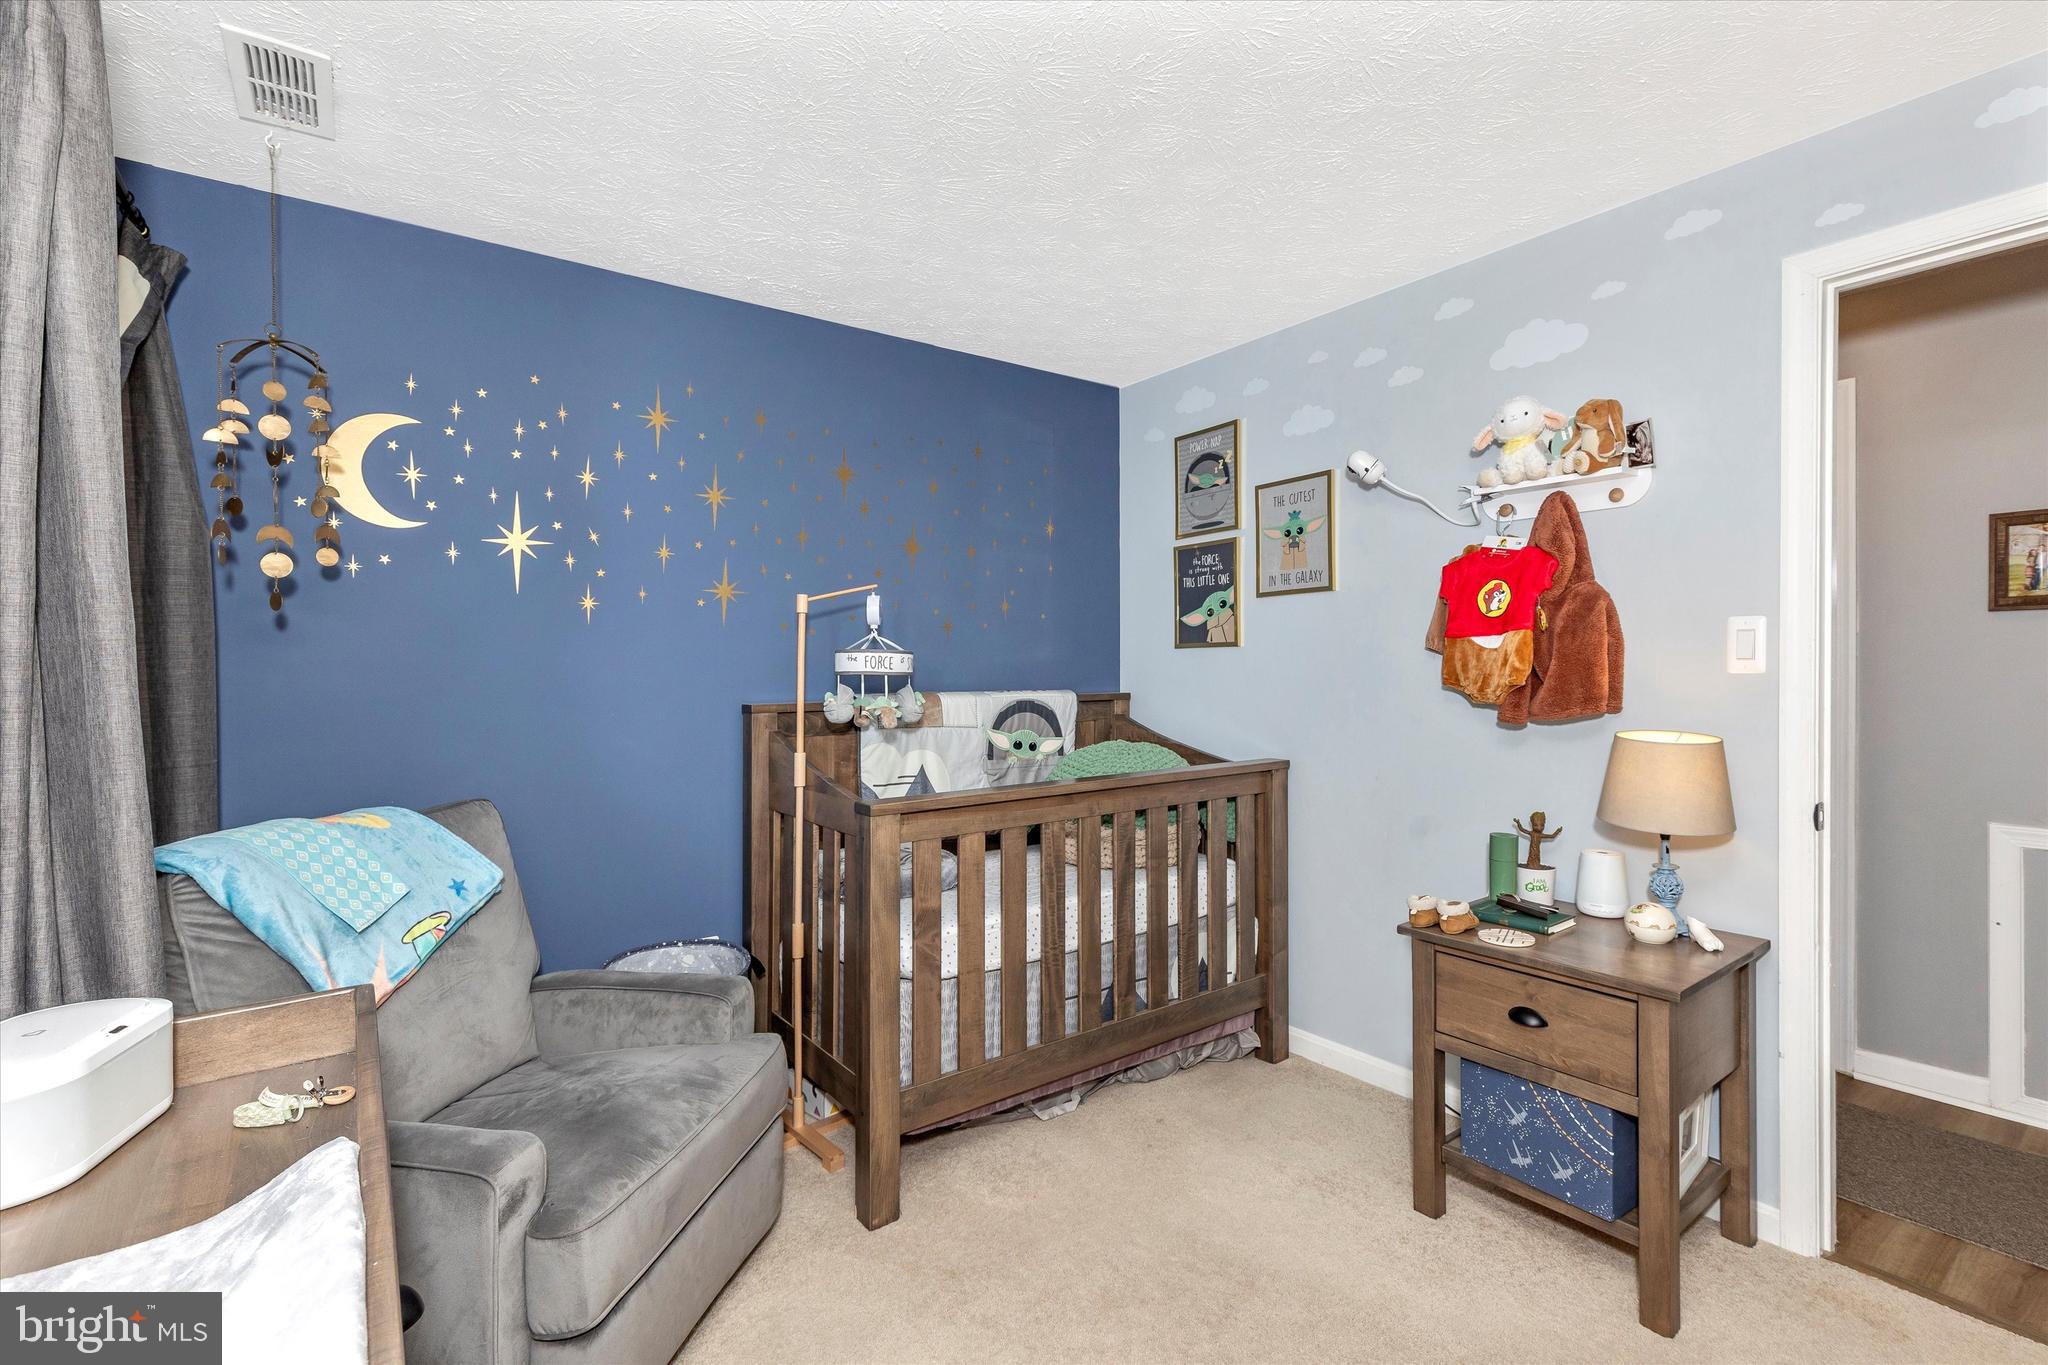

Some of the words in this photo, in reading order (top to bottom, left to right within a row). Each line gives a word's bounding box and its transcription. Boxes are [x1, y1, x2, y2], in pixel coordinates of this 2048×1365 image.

[1273, 495, 1286, 507] THE
[1289, 488, 1315, 506] CUTEST
[1192, 557, 1201, 566] the
[1201, 553, 1219, 566] FORCE
[1211, 561, 1224, 571] with
[1183, 577, 1196, 588] THIS
[1197, 574, 1216, 587] LITTLE
[1217, 572, 1230, 585] ONE
[1268, 575, 1277, 587] IN
[1280, 572, 1292, 585] THE
[1295, 569, 1324, 585] GALAXY
[847, 654, 858, 662] the
[864, 655, 894, 670] FORCE
